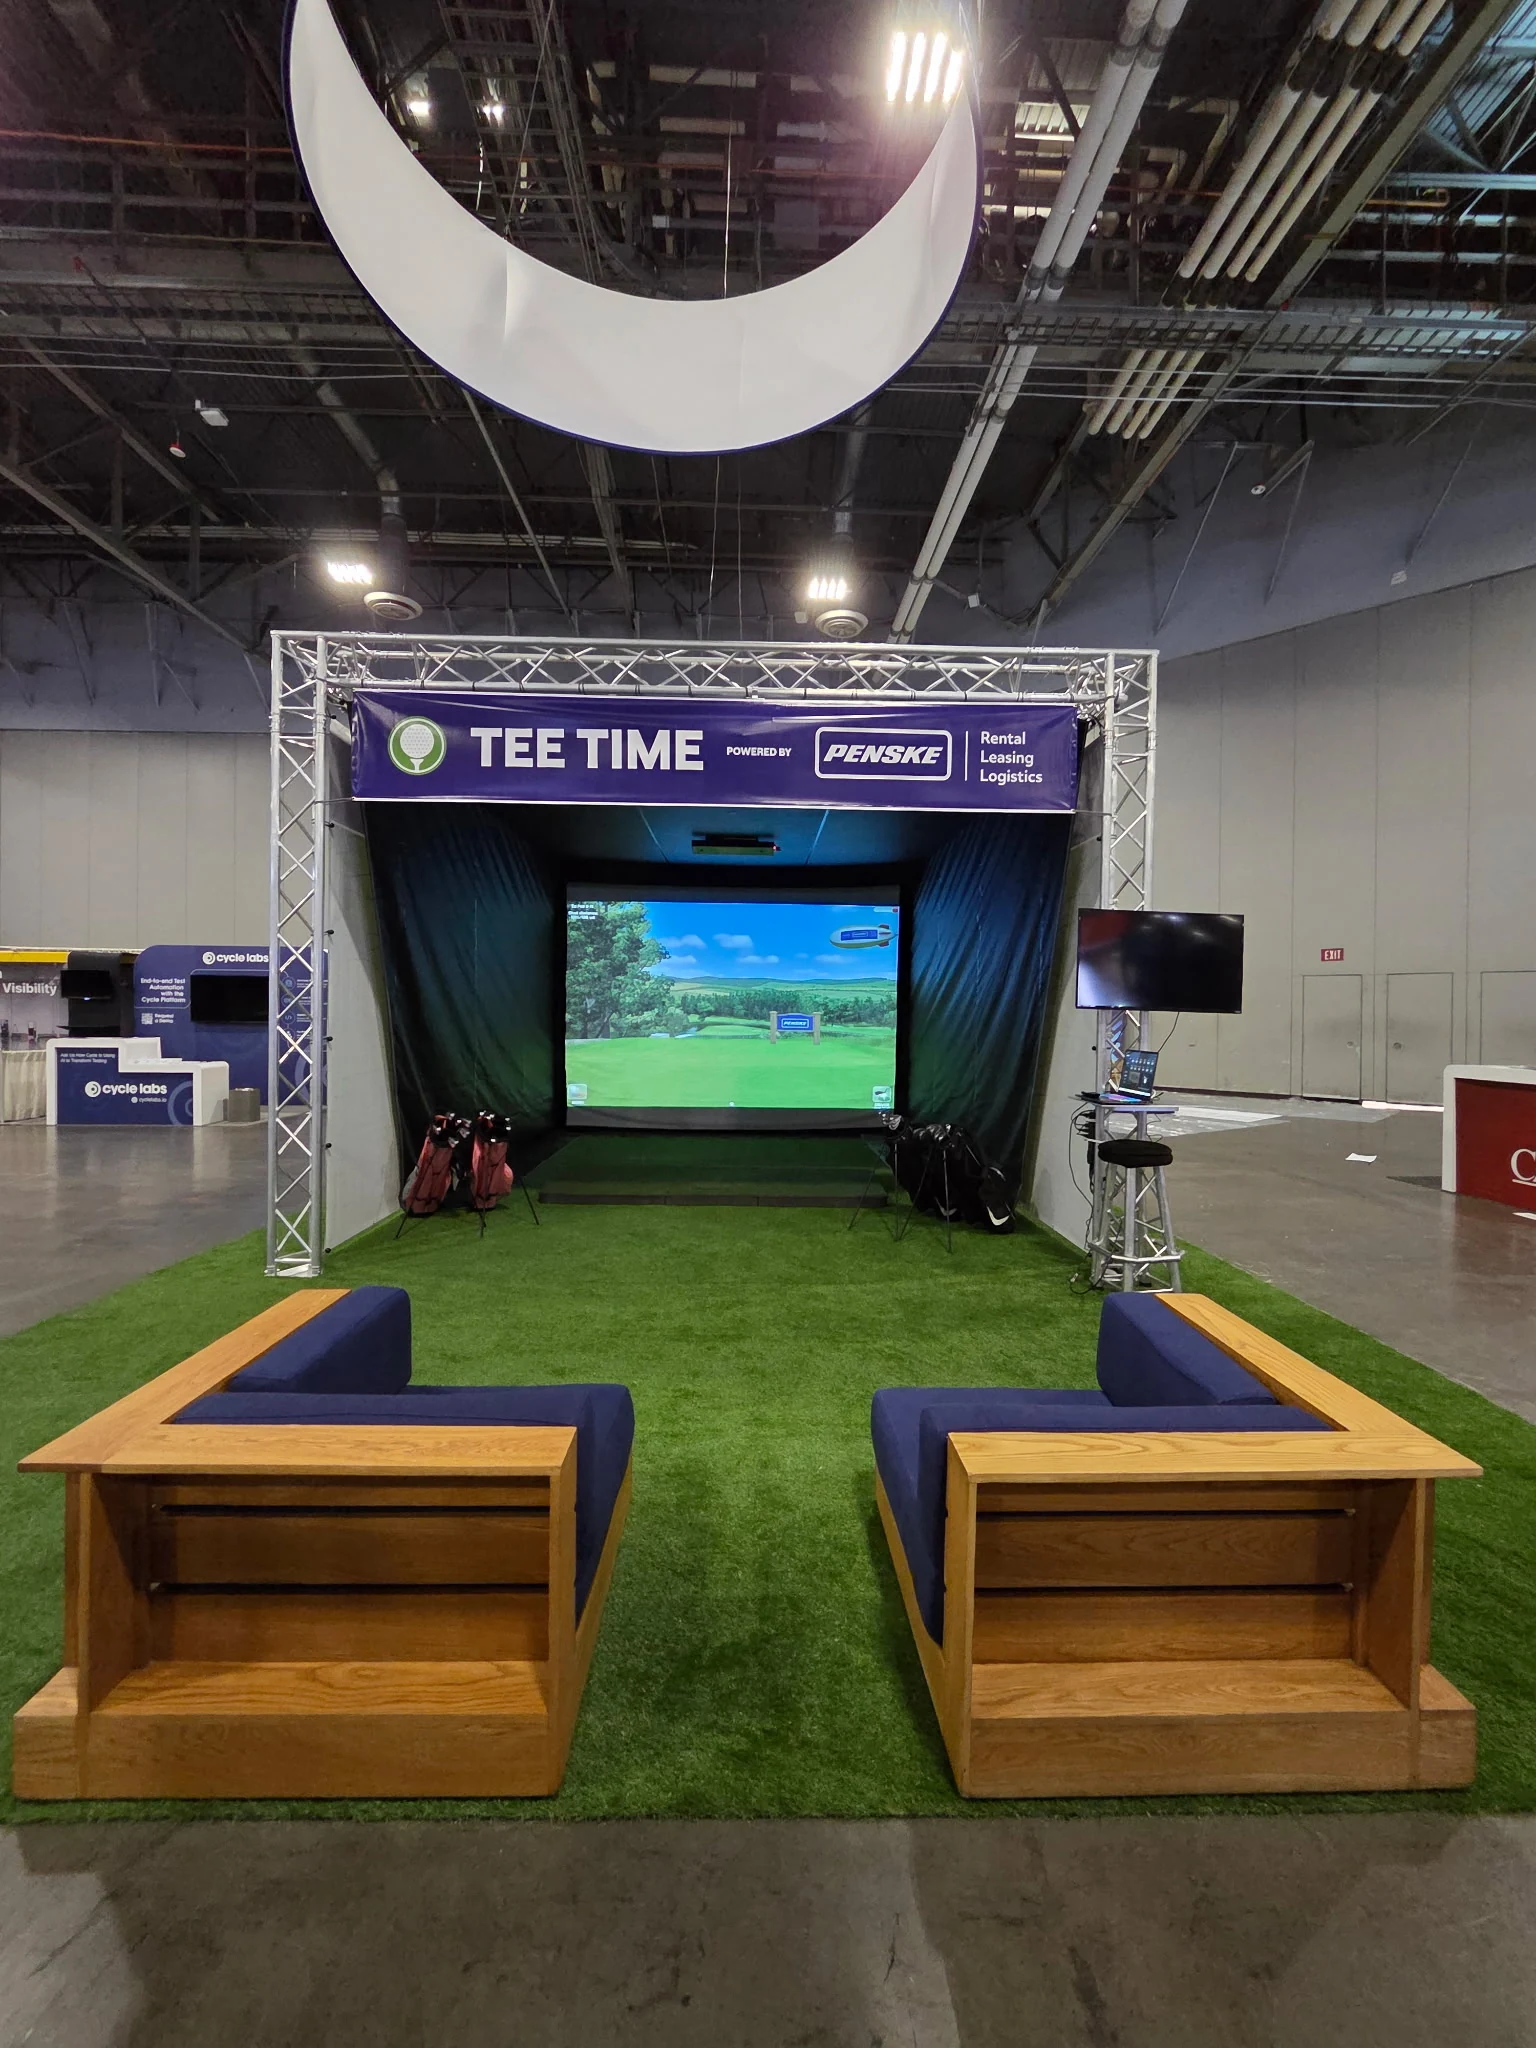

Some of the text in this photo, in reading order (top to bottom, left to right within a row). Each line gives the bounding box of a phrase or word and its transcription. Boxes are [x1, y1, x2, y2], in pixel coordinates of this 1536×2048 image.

[980, 731, 1026, 746] Rental
[470, 727, 705, 771] TEE TIME
[726, 746, 792, 757] POWERED BY
[823, 744, 944, 765] PENSKE
[980, 750, 1034, 768] Leasing
[979, 769, 1043, 786] Logistics
[216, 953, 269, 964] cycle labs
[1324, 949, 1342, 961] EXIT
[2, 982, 58, 997] Visibility
[141, 996, 160, 1004] Cycle
[102, 1083, 168, 1096] cycle labs
